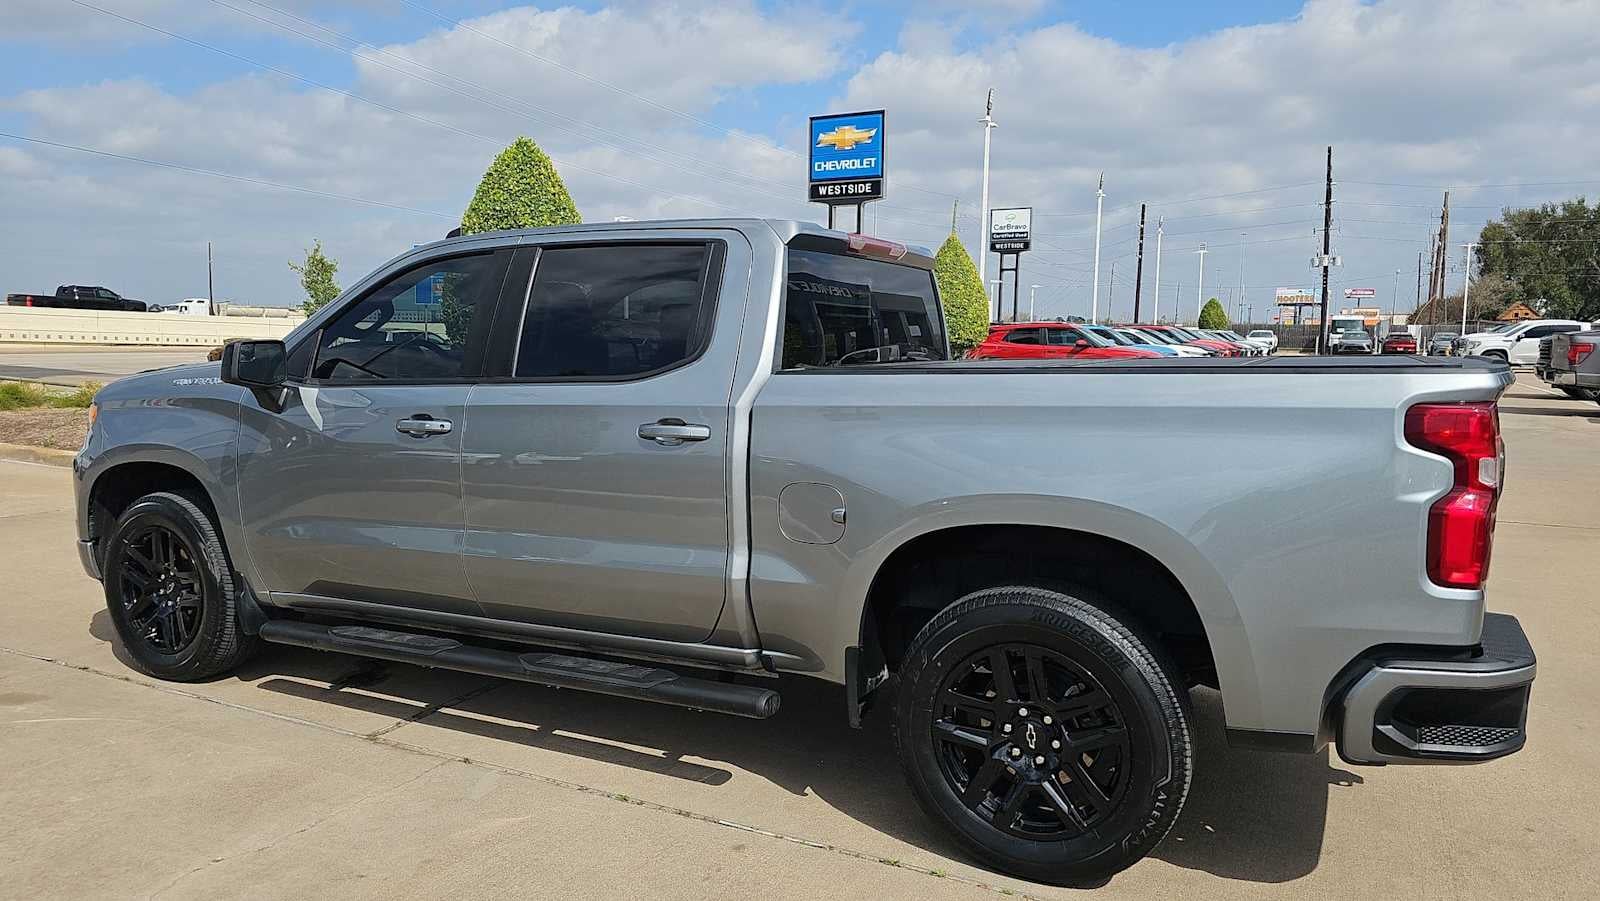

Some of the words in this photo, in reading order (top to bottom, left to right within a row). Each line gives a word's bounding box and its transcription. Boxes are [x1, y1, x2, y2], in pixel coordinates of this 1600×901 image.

[815, 158, 876, 172] CHEVROLET
[819, 183, 872, 195] WESTSIDE
[995, 242, 1025, 250] WESTSIDE
